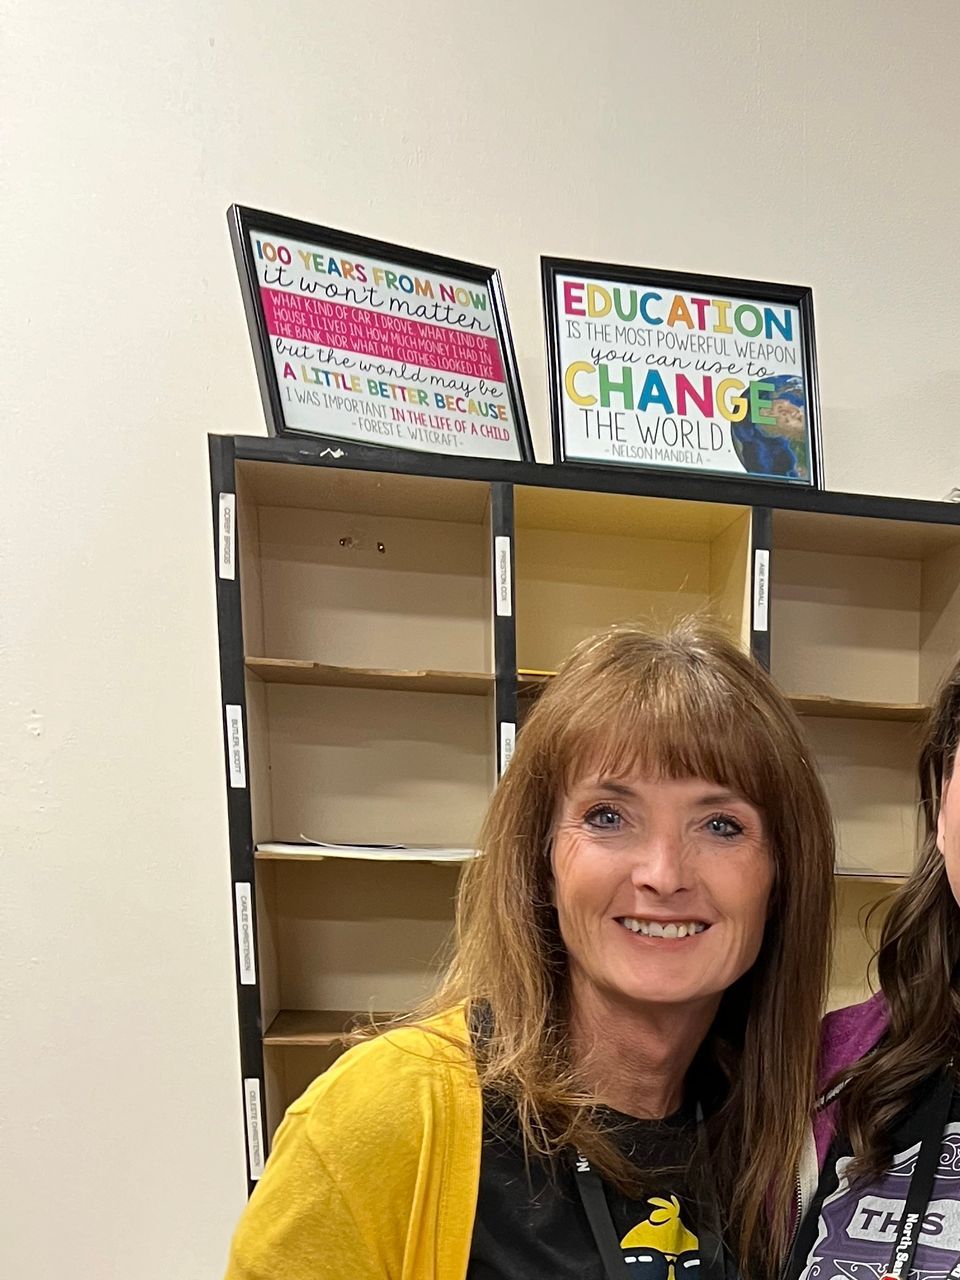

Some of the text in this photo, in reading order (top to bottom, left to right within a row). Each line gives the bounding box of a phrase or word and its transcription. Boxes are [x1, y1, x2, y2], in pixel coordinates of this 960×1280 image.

[256, 240, 487, 311] 100 YEARS FROM NOW
[263, 265, 490, 331] it won't matter
[270, 291, 488, 350] WHAT KIND OF CAR WHAT KIND OF
[273, 306, 492, 365] HOUSE LIVED HOW MUCH MONEY HAD IN
[563, 281, 793, 341] EDUCATION
[273, 321, 494, 378] THE NOR WHAT MY CLOTHES LOOKED LIKE
[275, 337, 503, 398] but the world may be
[566, 319, 796, 364] IS THE MOST POWERFUL WEAPON
[590, 347, 775, 379] you can use to
[283, 362, 508, 421] A LITTLE BETTER BECAUSE
[295, 389, 510, 441] WAS IMPORTANT IN THE LIFE OF CHILD
[564, 360, 777, 425] CHANGE
[358, 419, 394, 437] FOREST
[579, 408, 627, 442] THE
[612, 444, 703, 465] NELSON MANDELA
[859, 1207, 943, 1234] THS
[896, 1213, 920, 1252] North
